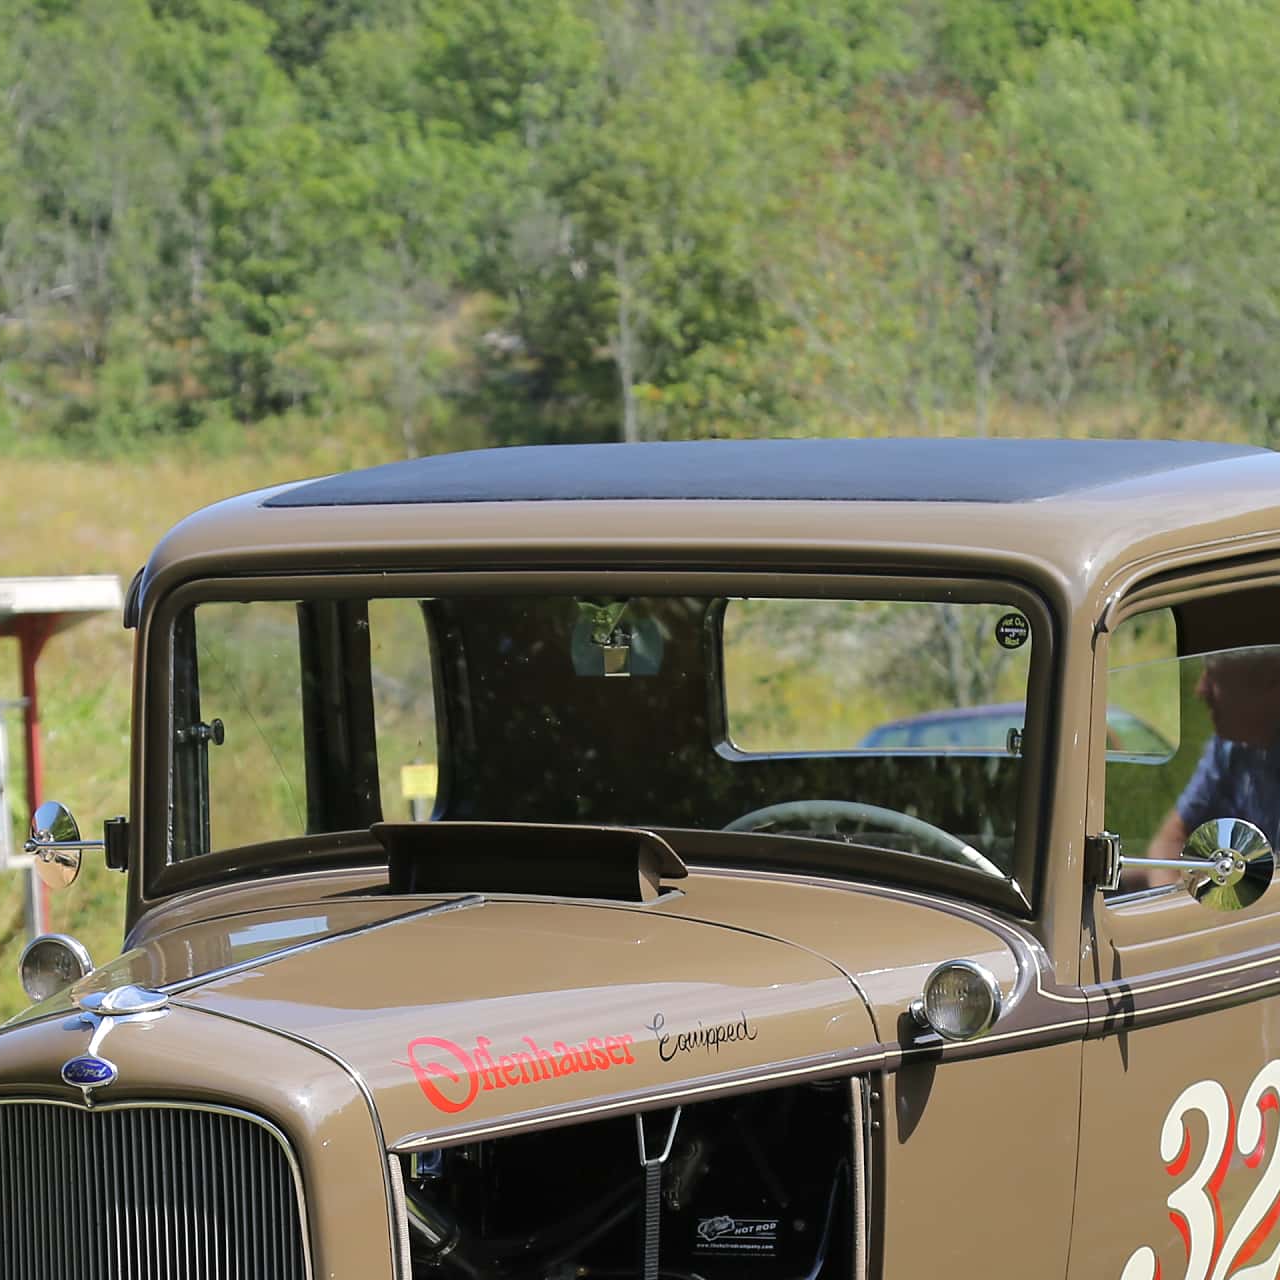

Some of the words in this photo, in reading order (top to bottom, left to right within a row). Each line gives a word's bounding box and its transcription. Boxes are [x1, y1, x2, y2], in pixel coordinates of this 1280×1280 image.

[392, 1034, 636, 1114] Offenhauser
[644, 1010, 758, 1063] Equipped
[734, 1226, 755, 1235] HOT
[756, 1223, 777, 1232] ROD
